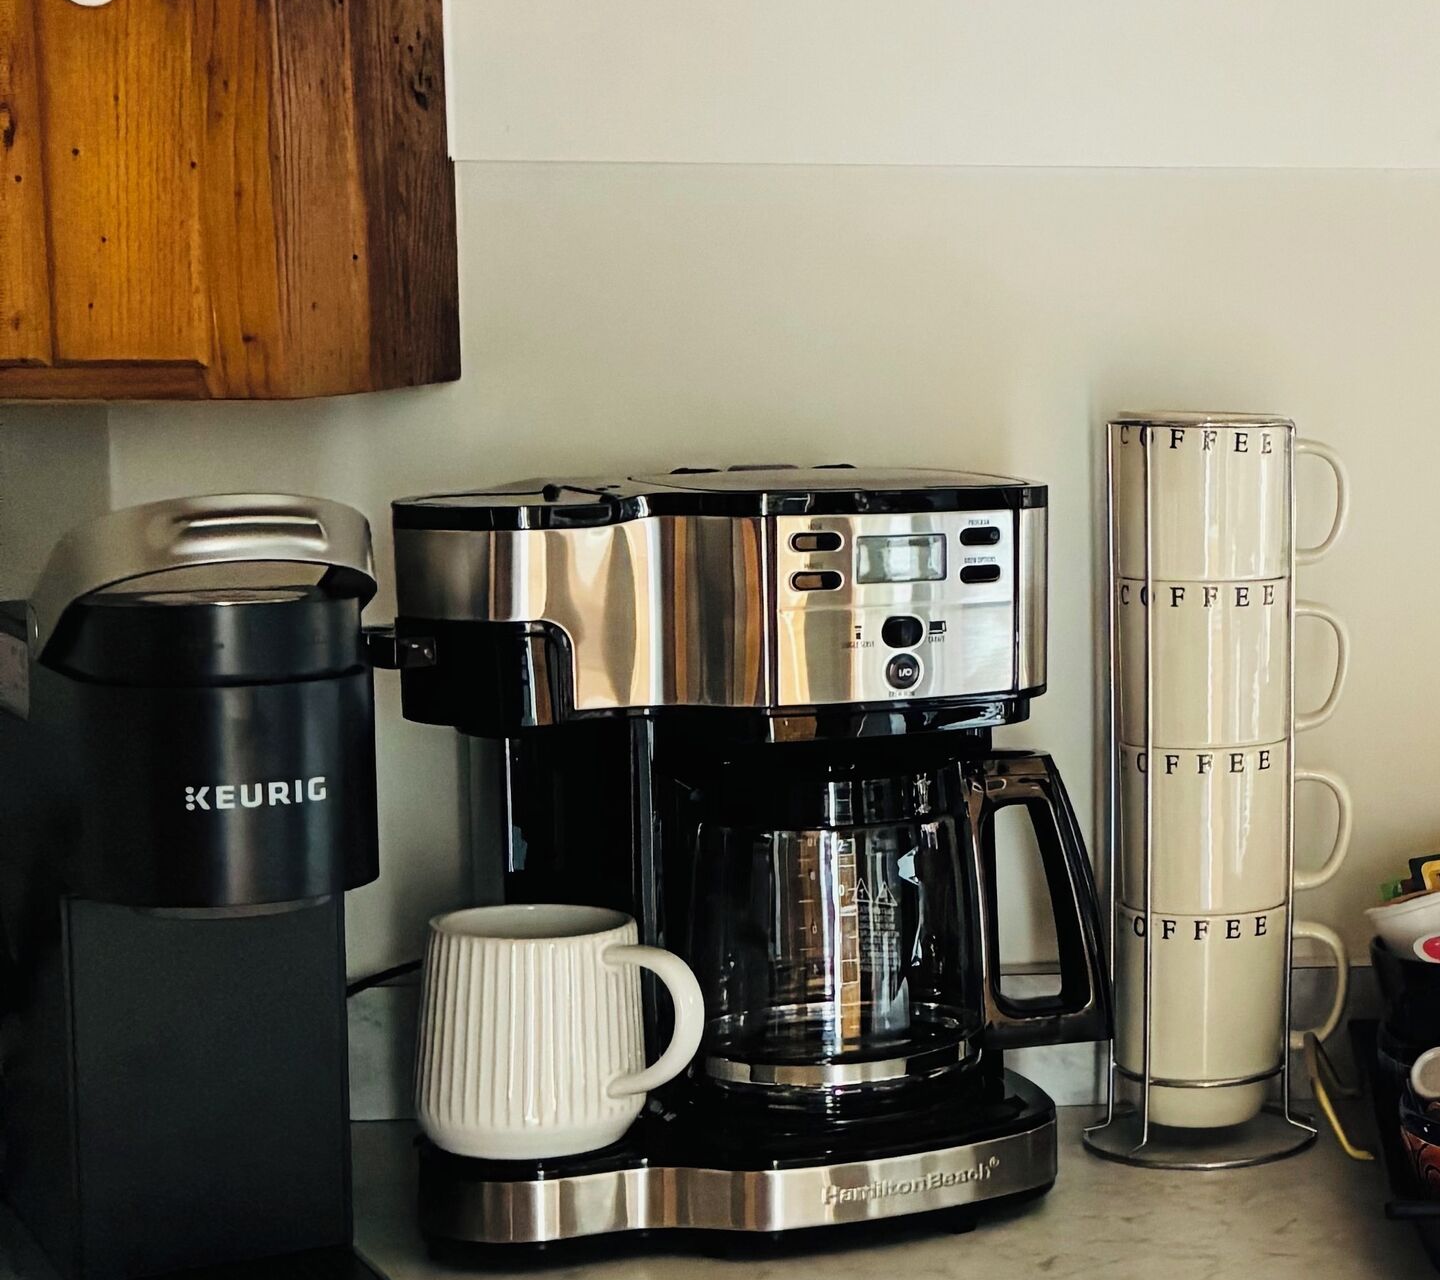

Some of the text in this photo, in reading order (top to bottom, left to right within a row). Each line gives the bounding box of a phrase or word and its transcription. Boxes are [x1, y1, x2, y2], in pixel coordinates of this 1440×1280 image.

[1120, 424, 1273, 455] COFFEE
[1120, 584, 1274, 608] COFFEE
[1136, 750, 1271, 775] OFFEE
[185, 776, 327, 811] KEURIG
[1133, 915, 1268, 940] OFFEE
